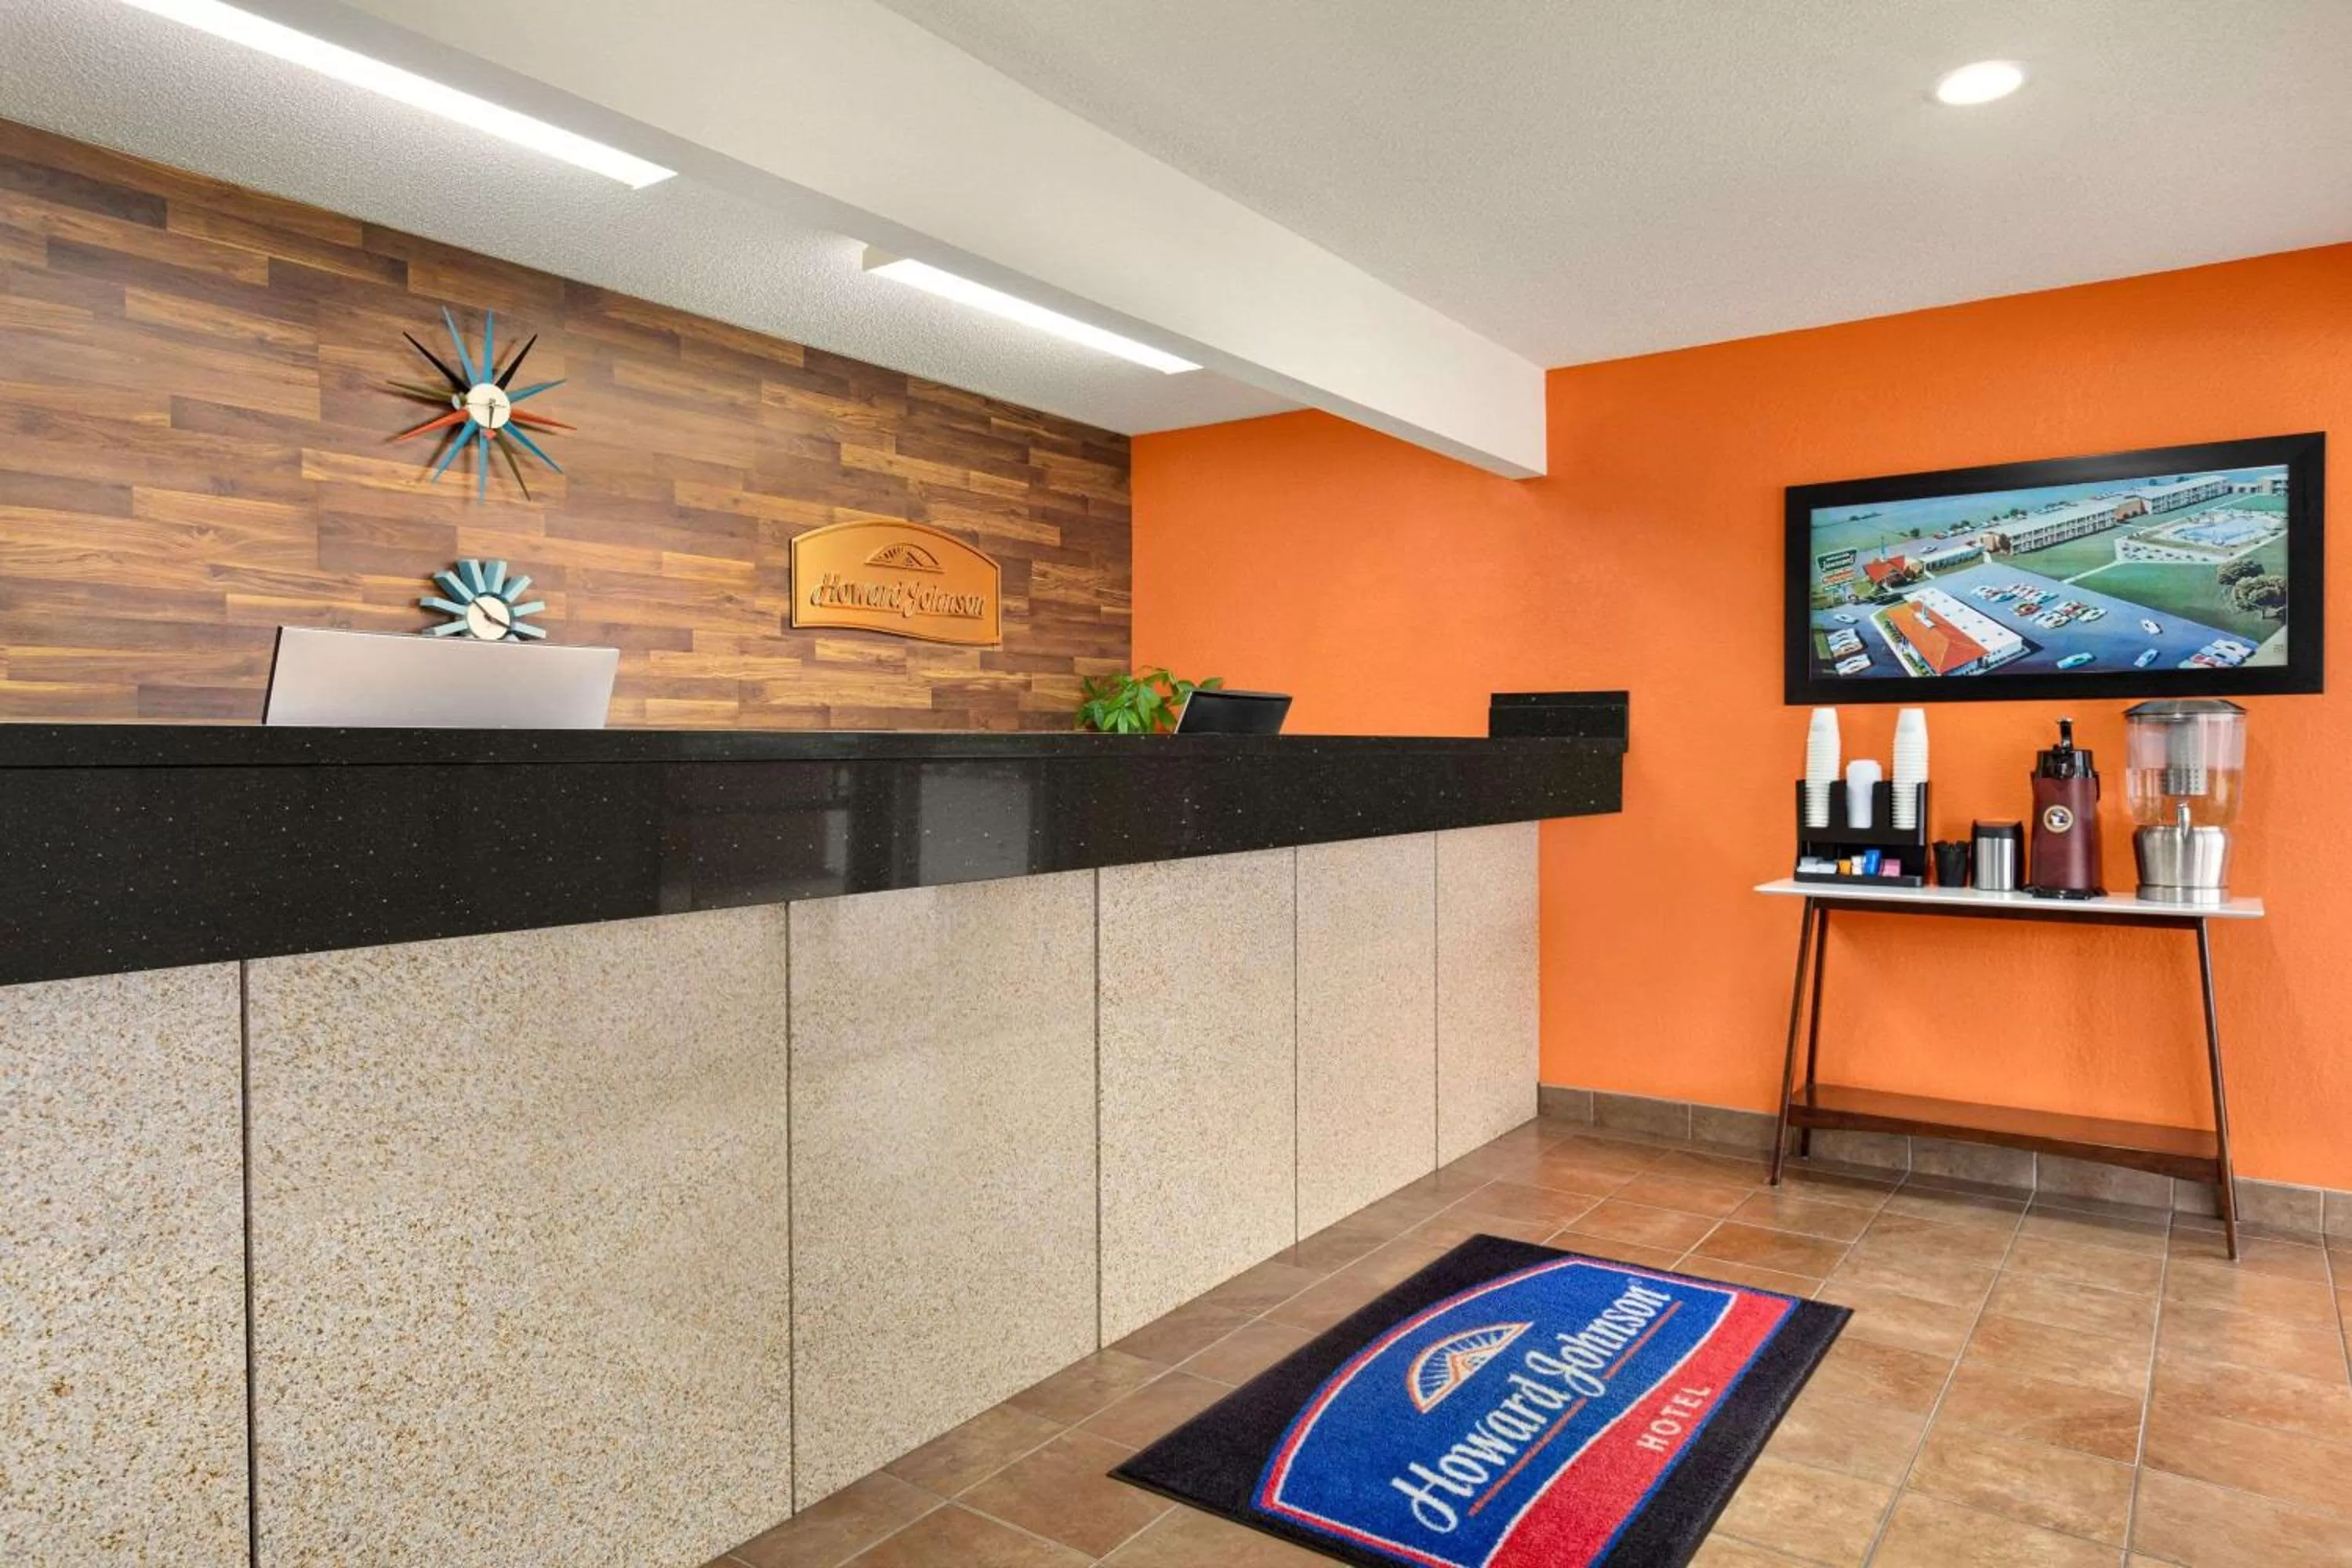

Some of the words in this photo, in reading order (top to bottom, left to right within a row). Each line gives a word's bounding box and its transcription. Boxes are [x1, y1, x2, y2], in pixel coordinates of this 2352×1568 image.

[810, 573, 902, 607] Howard
[902, 580, 985, 618] Johnson
[1390, 1374, 1570, 1534] Howard
[1525, 1284, 1671, 1398] Johnson
[1636, 1386, 1711, 1454] HOTEL
